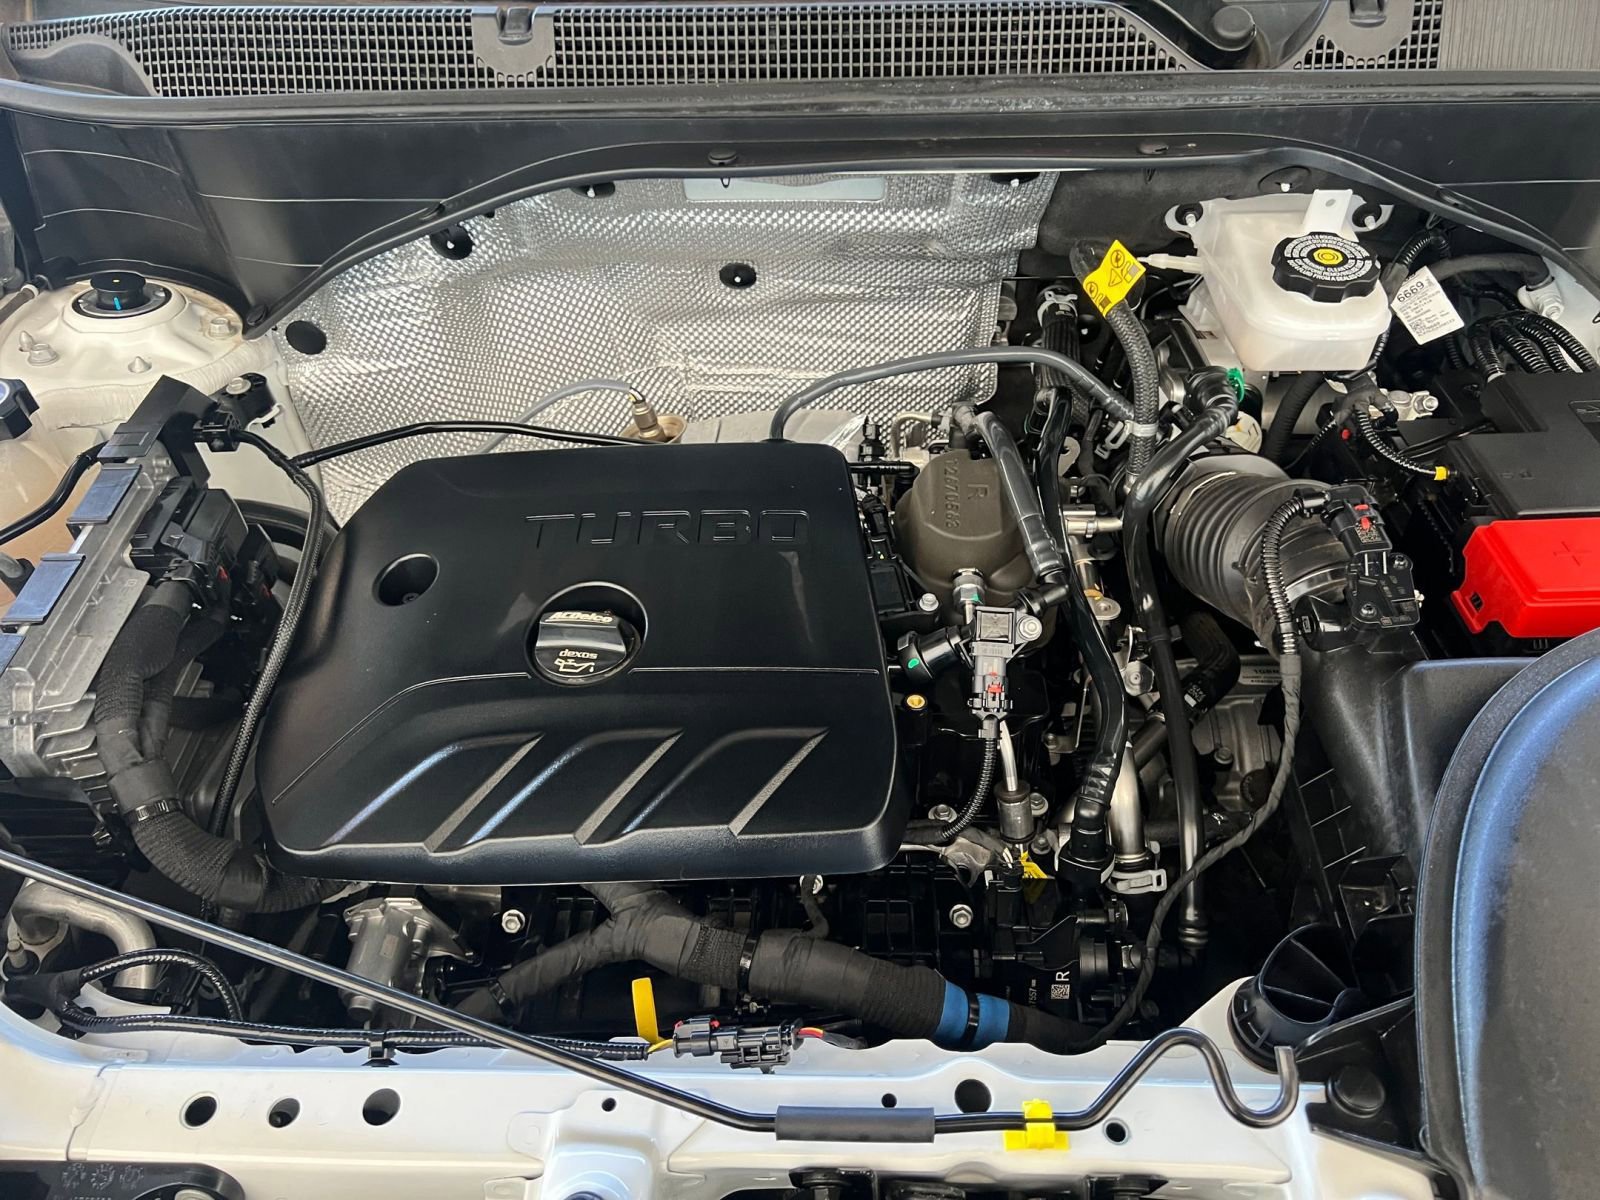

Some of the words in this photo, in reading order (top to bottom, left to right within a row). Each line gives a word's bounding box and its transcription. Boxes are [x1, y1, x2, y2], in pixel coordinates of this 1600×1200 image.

[1396, 281, 1425, 302] 6669
[967, 483, 989, 500] R
[525, 509, 809, 548] TURBO
[547, 611, 613, 623] ACDelco
[558, 648, 599, 660] dexos
[1055, 970, 1070, 981] R
